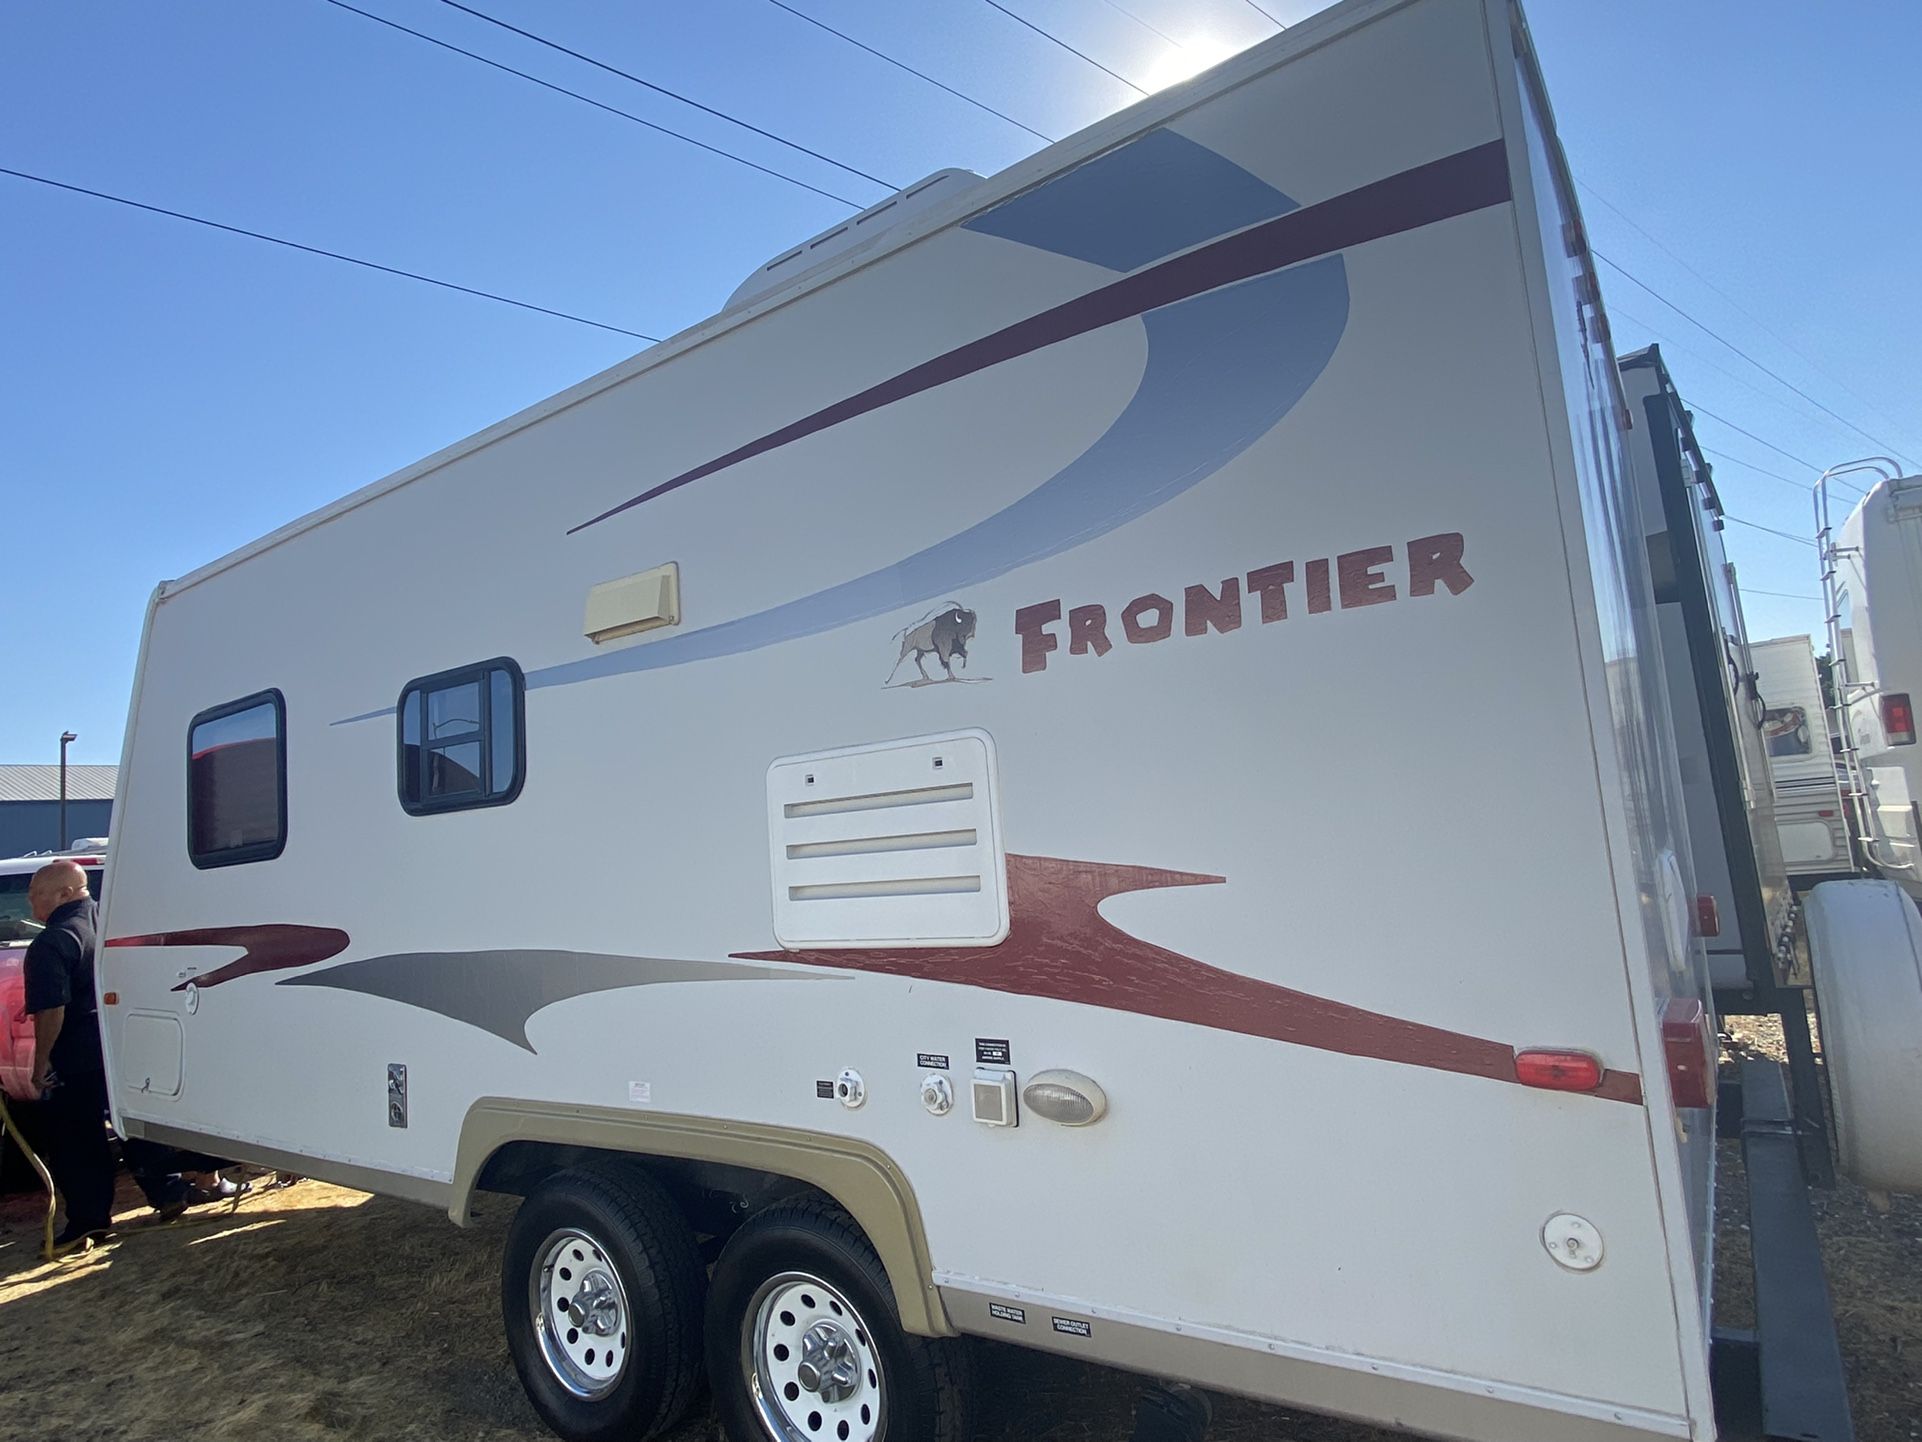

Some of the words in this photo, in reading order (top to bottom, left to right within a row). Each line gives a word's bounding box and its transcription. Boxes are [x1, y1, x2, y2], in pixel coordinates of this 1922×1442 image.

[1015, 532, 1475, 674] FRONTIER
[1053, 1318, 1070, 1326] SEWER
[1070, 1320, 1089, 1330] OUTLET
[1057, 1324, 1087, 1335] CONNECTION
